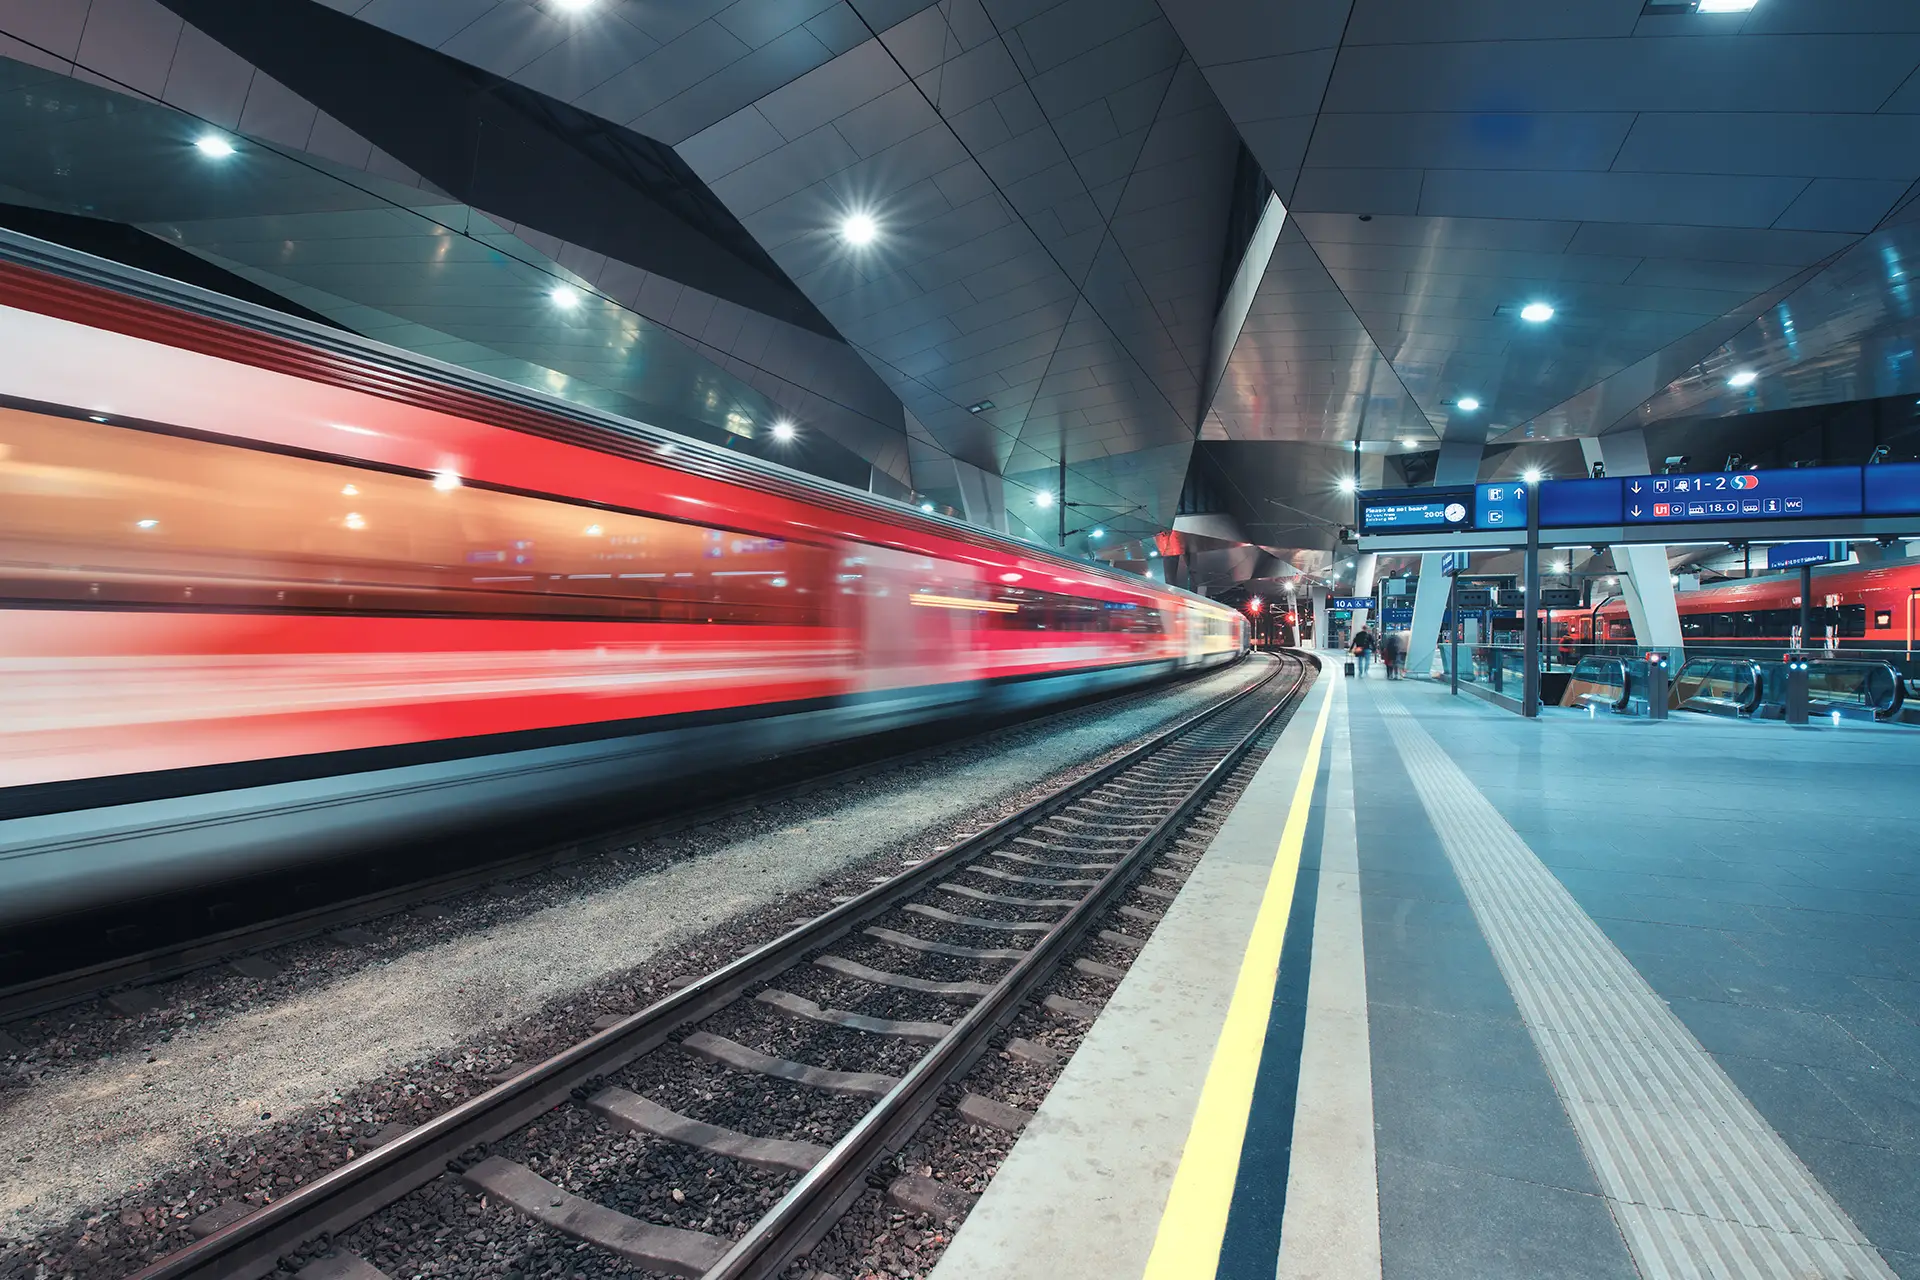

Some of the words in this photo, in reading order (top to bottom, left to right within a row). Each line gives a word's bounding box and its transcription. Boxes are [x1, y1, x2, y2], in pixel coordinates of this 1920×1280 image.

[1693, 478, 1701, 491] 1
[1715, 477, 1727, 490] 2
[1655, 505, 1668, 515] U1
